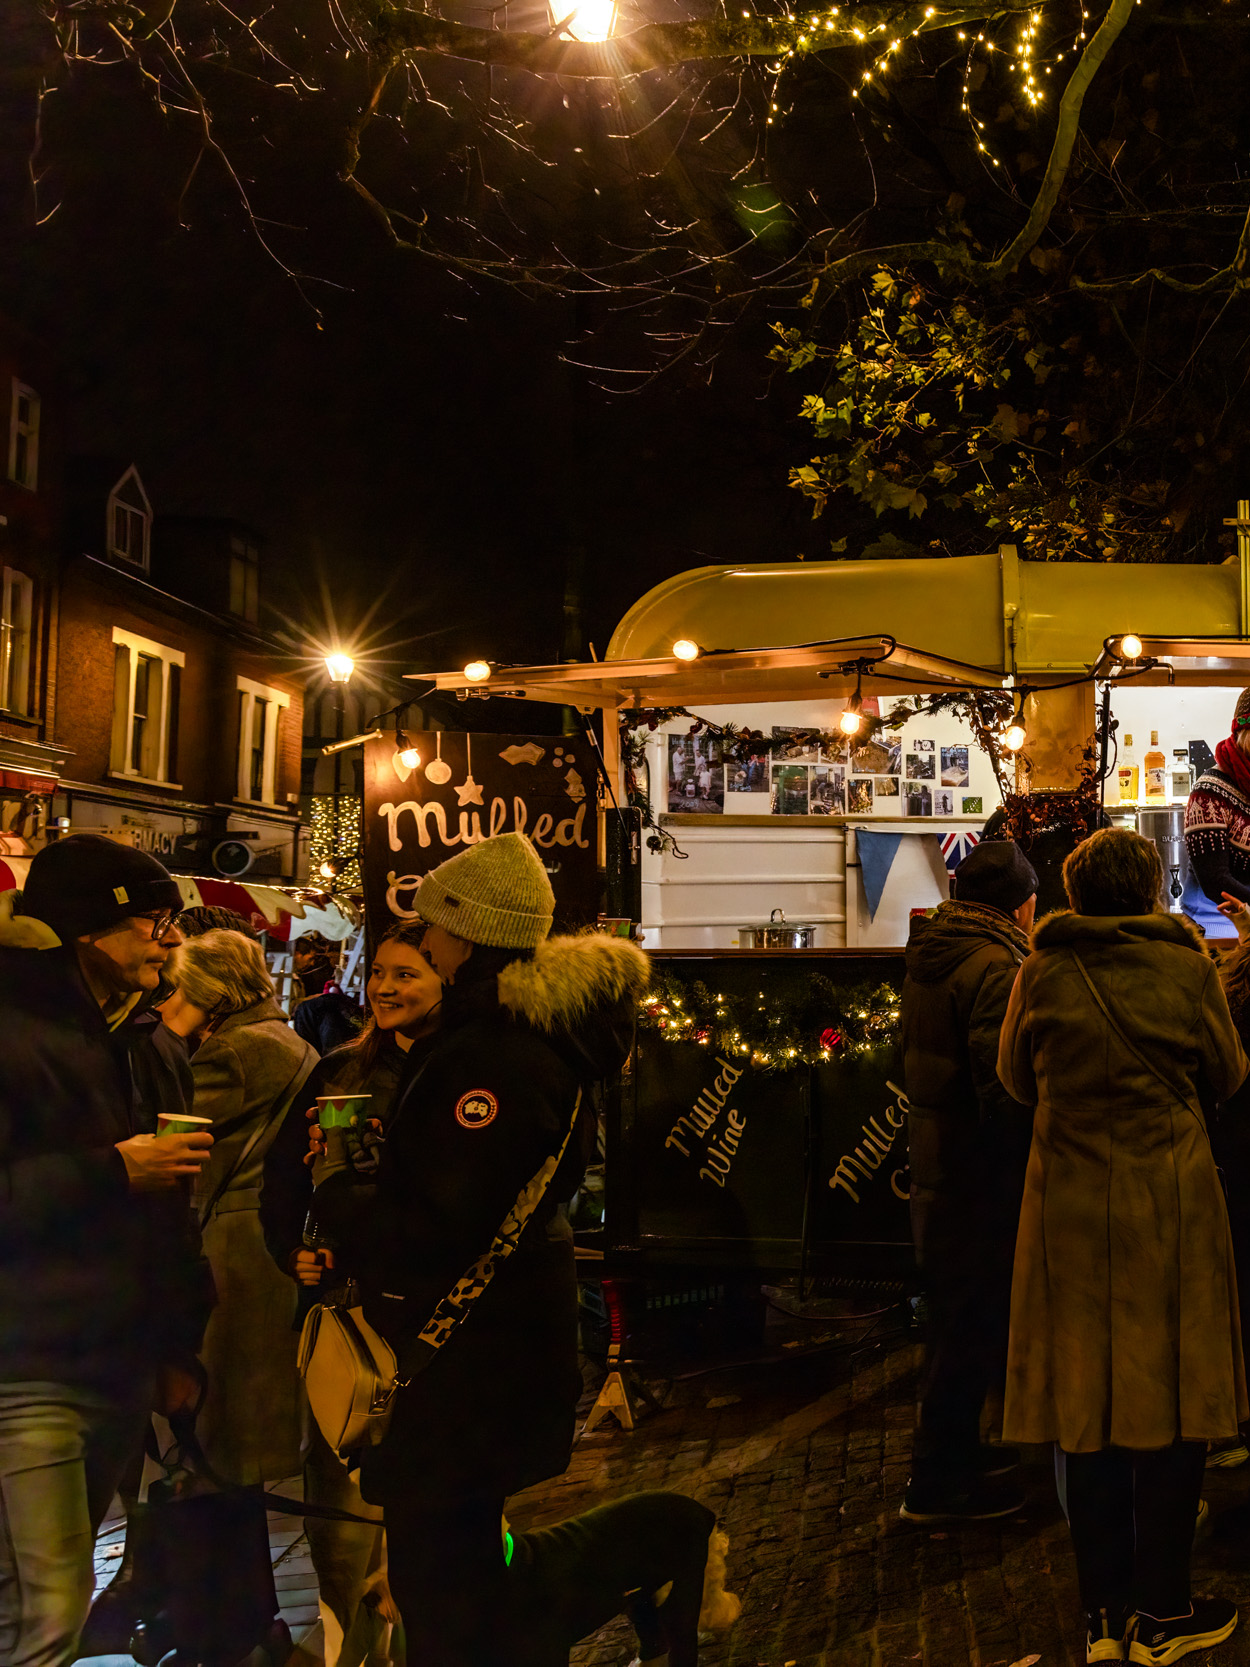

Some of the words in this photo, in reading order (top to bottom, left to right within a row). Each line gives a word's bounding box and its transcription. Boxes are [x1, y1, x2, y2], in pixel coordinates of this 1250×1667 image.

[134, 827, 178, 855] RMACY
[665, 1056, 744, 1157] Mulled
[699, 1108, 747, 1188] Wine
[829, 1080, 910, 1204] Mulled
